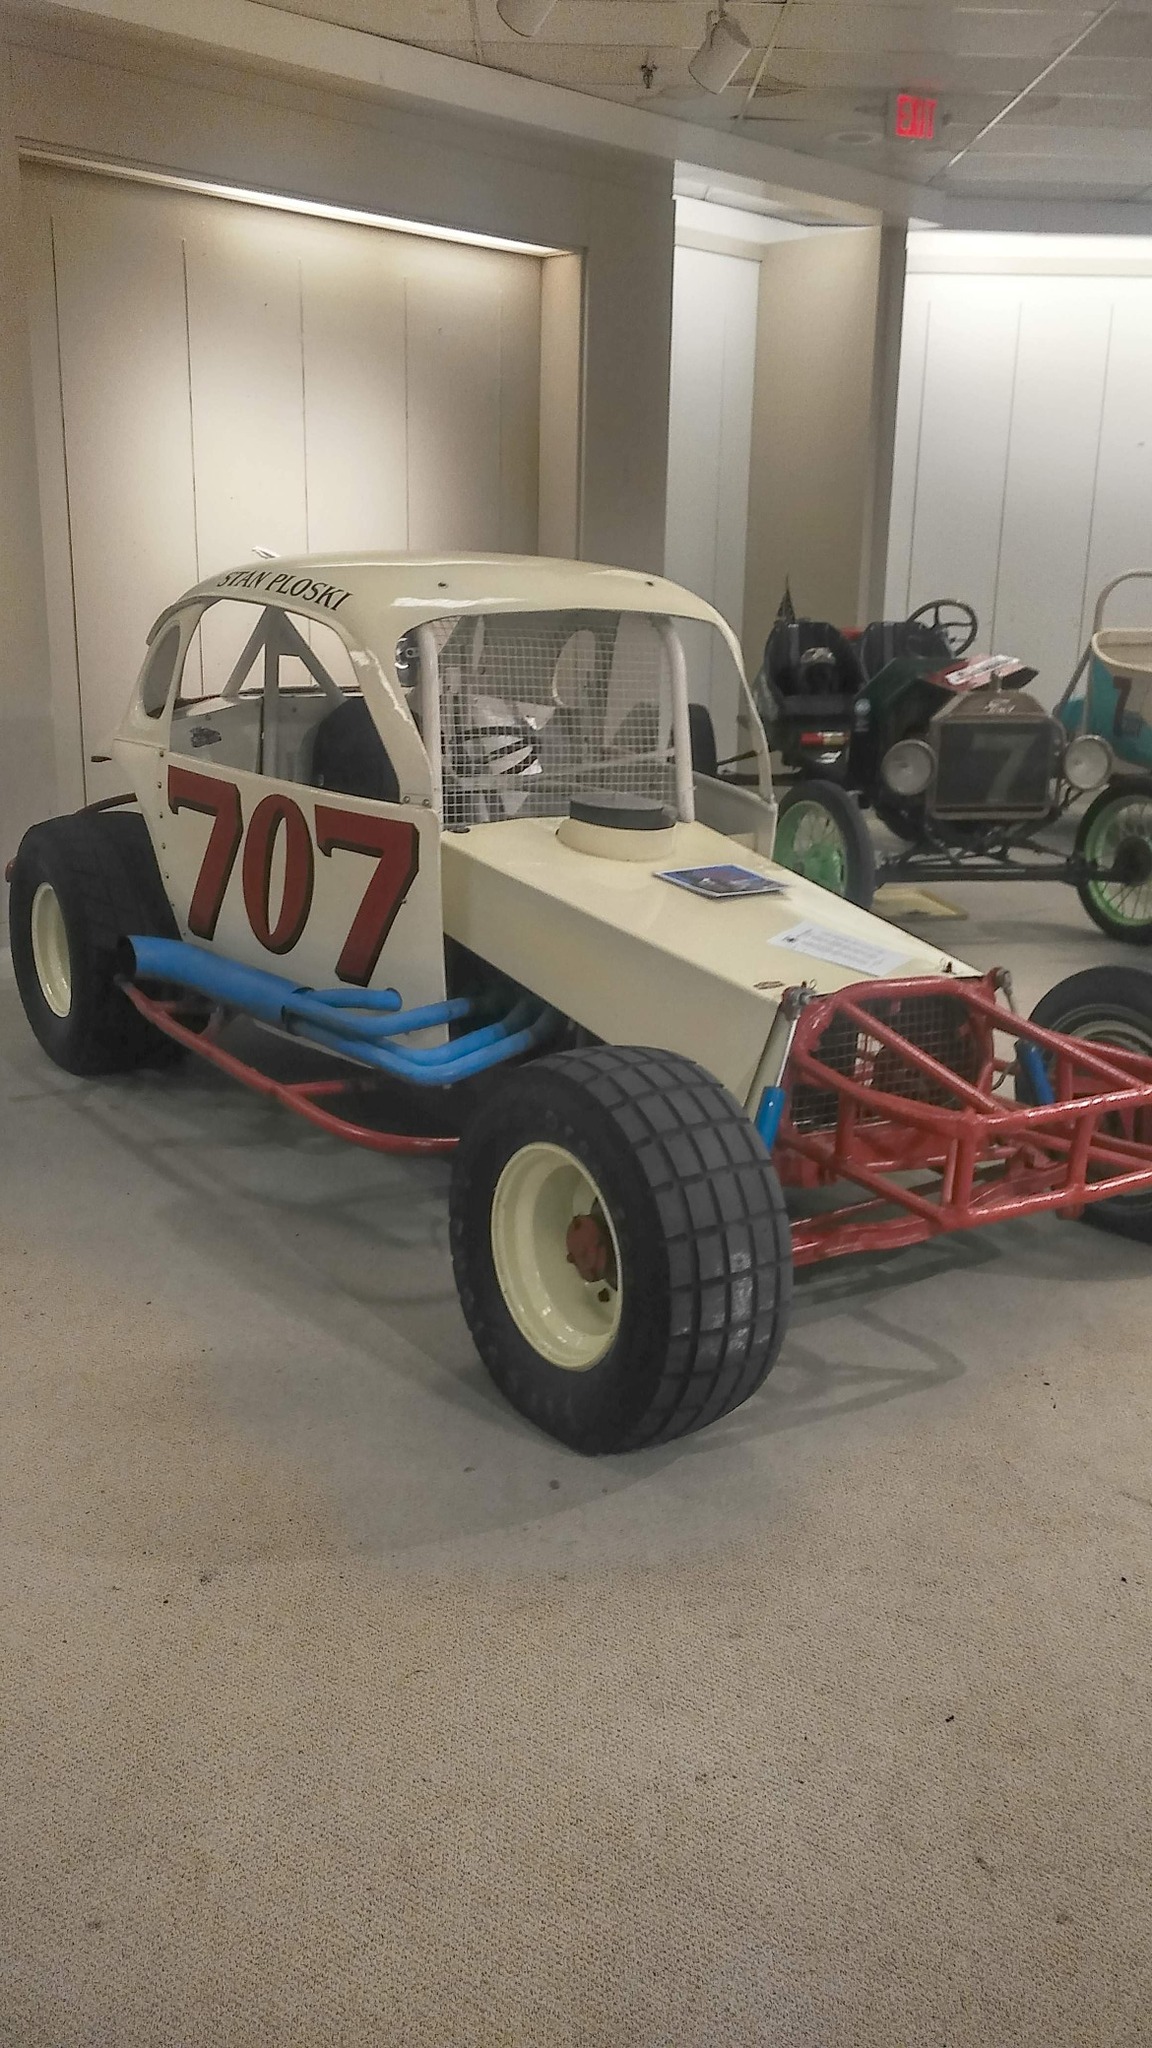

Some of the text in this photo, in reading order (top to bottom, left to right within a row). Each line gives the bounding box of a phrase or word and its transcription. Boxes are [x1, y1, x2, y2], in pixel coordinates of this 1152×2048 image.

[217, 570, 353, 611] STAN PLOSKI
[970, 734, 1038, 803] 7
[168, 764, 420, 988] 707
